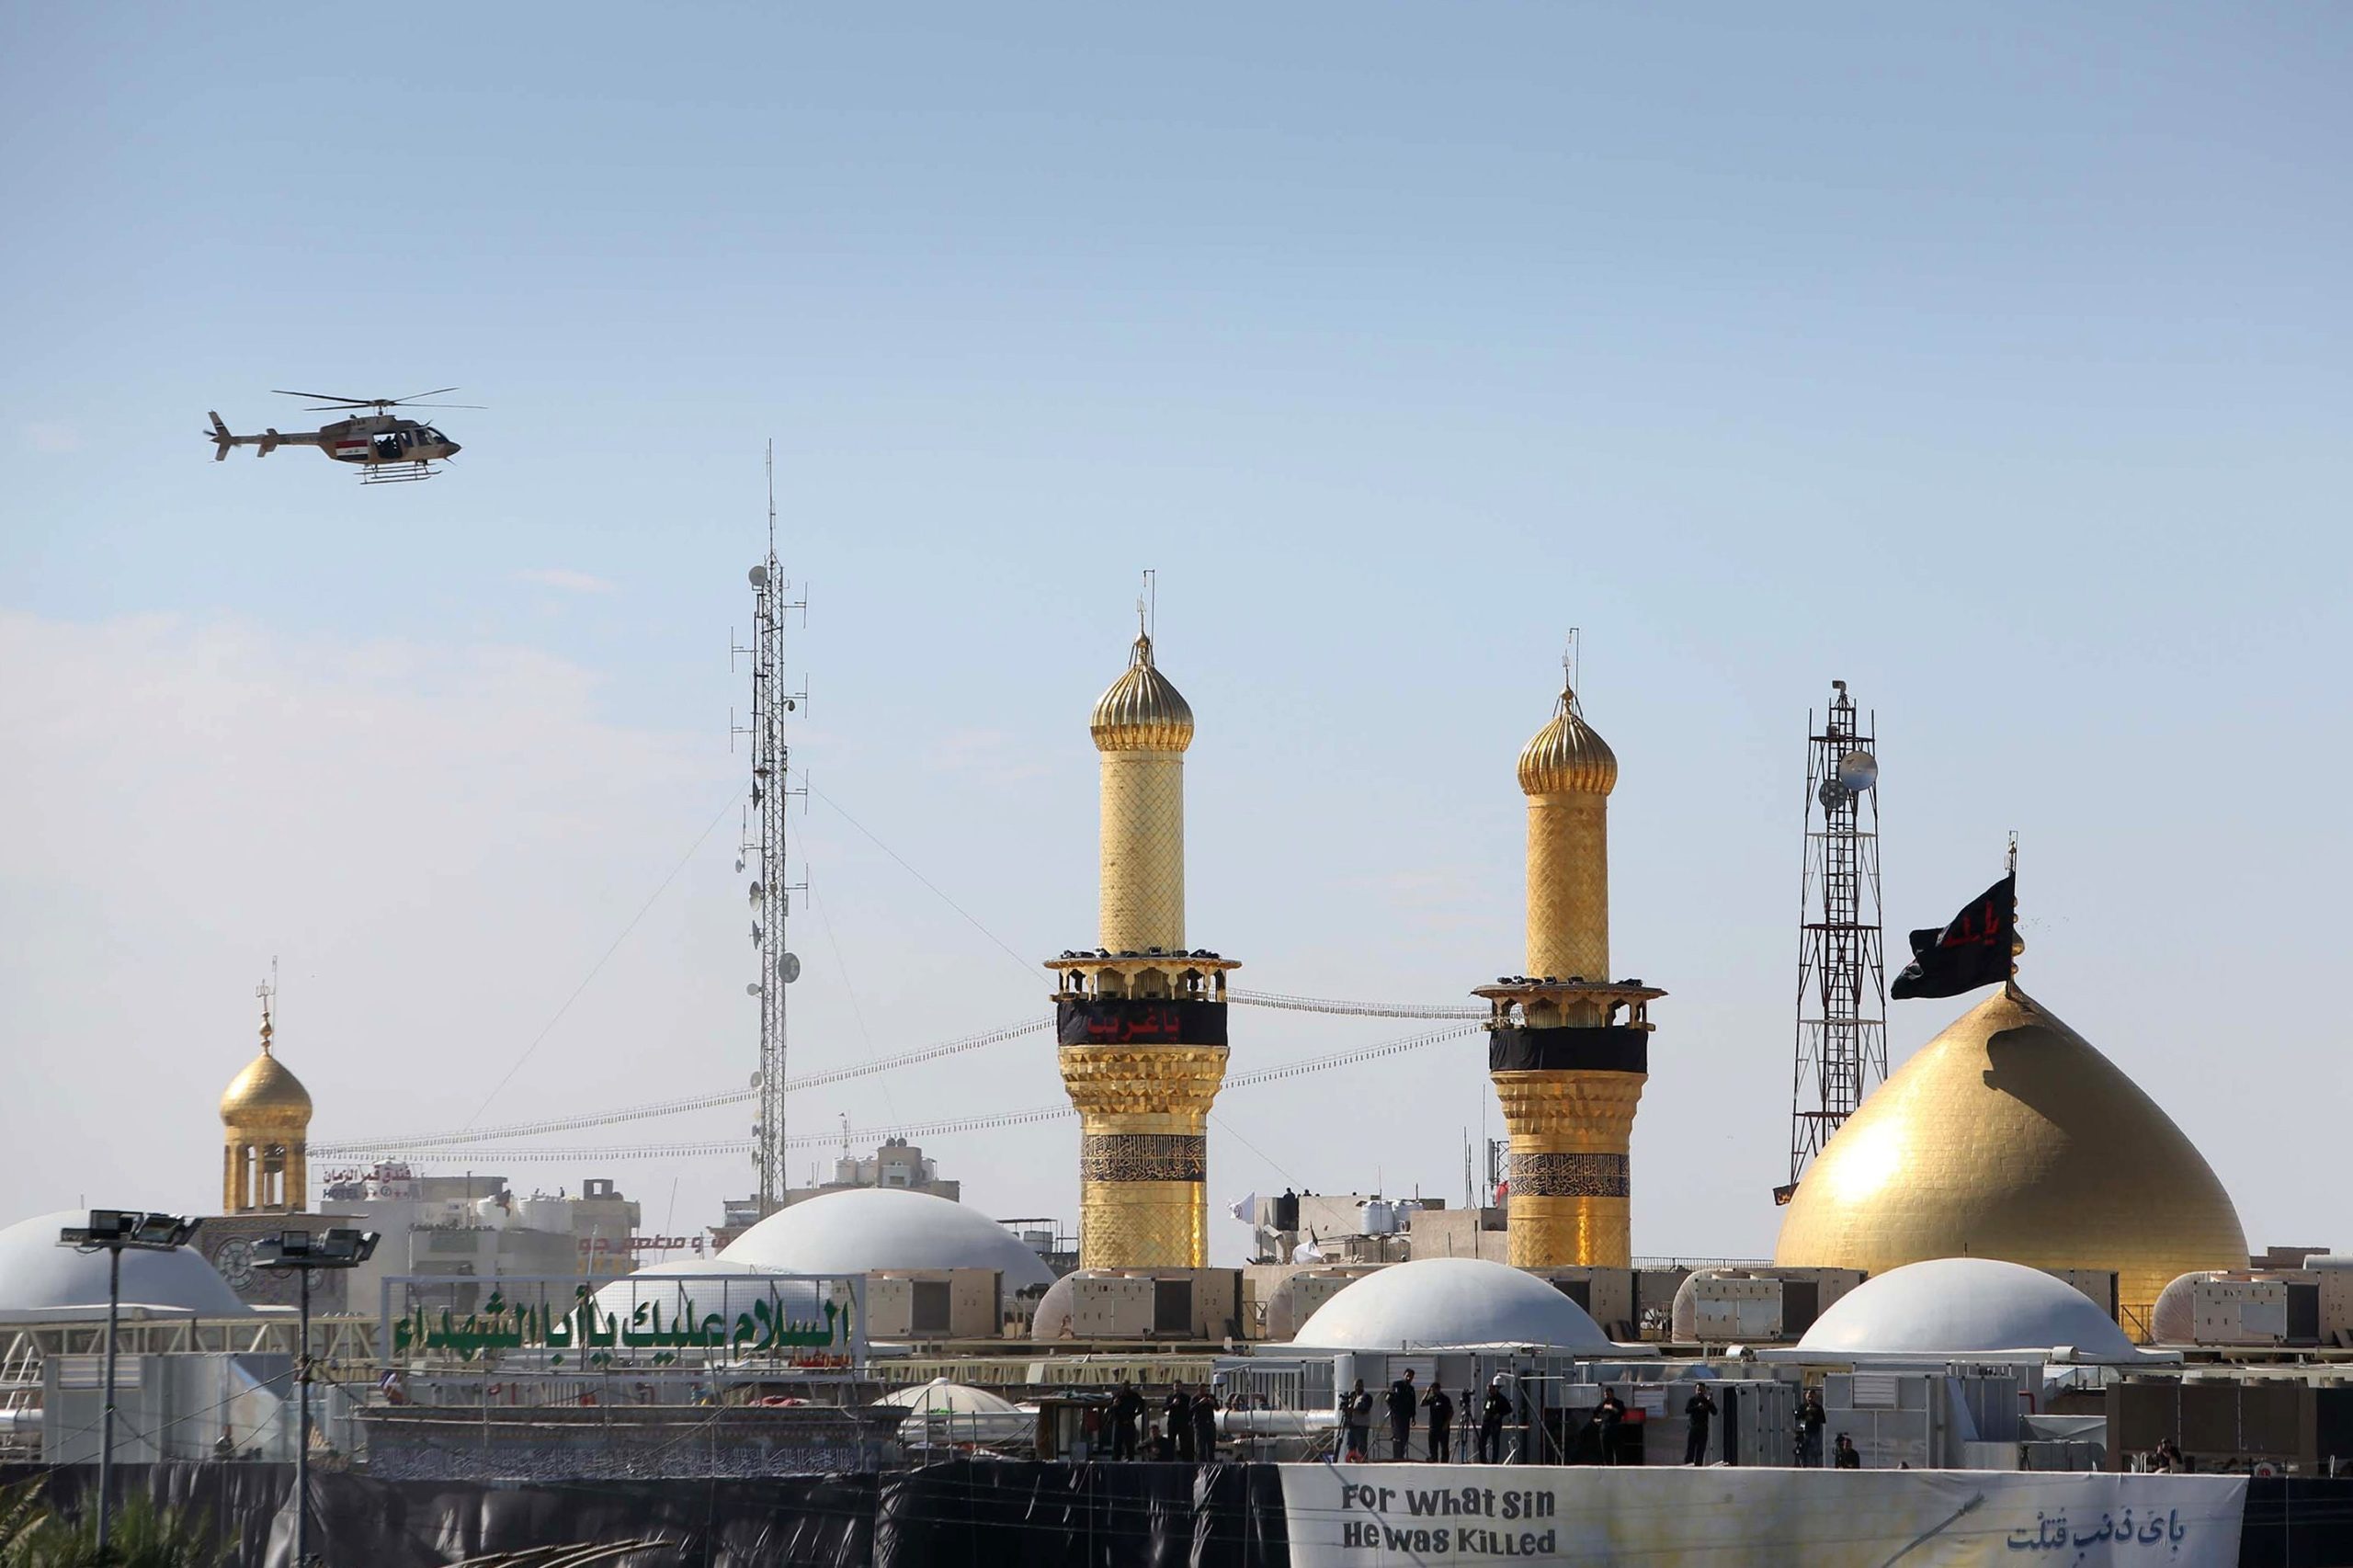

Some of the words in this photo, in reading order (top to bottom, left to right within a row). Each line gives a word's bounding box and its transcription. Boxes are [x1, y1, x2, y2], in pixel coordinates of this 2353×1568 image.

[393, 1290, 538, 1362] الشهداء
[586, 1301, 618, 1366] يا
[621, 1298, 726, 1365] عليك
[733, 1298, 851, 1360] السلام
[1405, 1487, 1495, 1517] What
[1501, 1490, 1555, 1519] Sin
[1343, 1521, 1380, 1549] He
